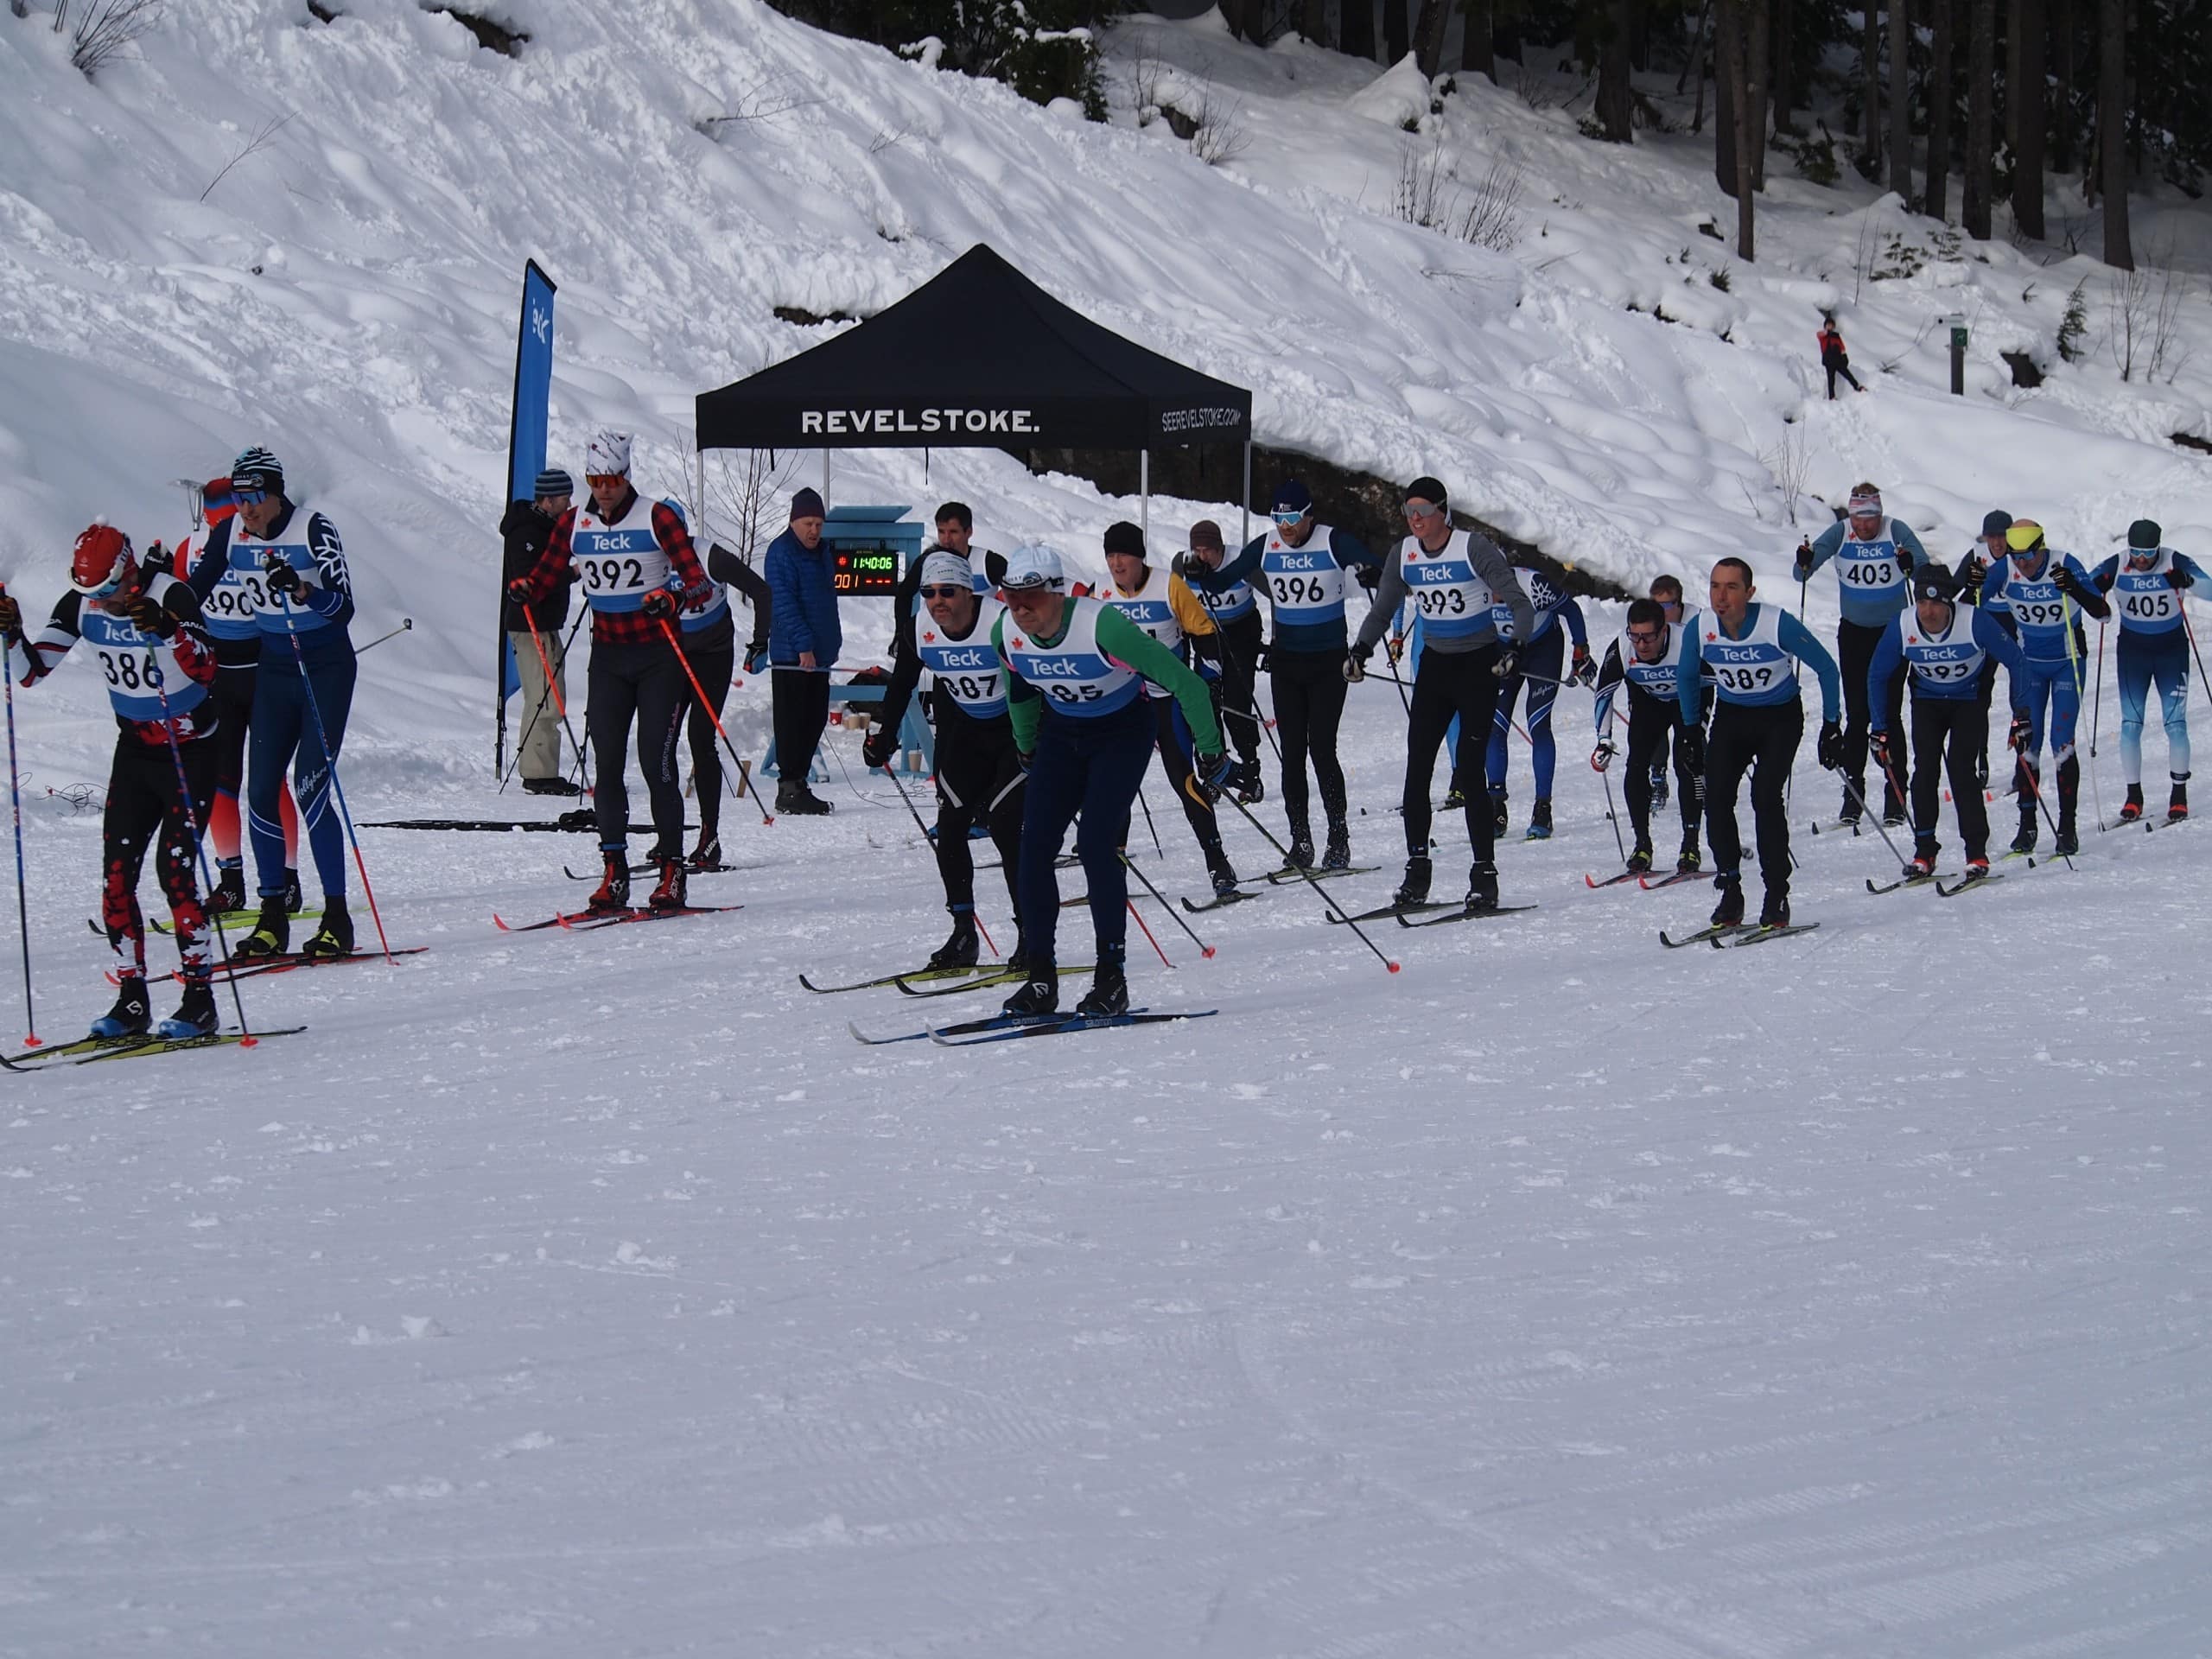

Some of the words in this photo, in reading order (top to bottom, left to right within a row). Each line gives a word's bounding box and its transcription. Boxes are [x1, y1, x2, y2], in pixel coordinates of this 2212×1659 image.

[802, 409, 1040, 434] REVELSTOKE.
[592, 533, 631, 550] Teck
[1855, 544, 1884, 557] Teck
[853, 556, 893, 569] 11:40:06
[1280, 554, 1313, 569] Teck
[585, 559, 644, 590] 392
[1419, 564, 1452, 582] Teck
[1847, 563, 1891, 584] 403
[1274, 576, 1324, 603] 396
[2131, 576, 2161, 589] Teck
[2019, 585, 2053, 599] Teck
[1417, 588, 1465, 615] 393
[2126, 594, 2169, 617] 405
[2016, 604, 2063, 624] 399
[102, 620, 144, 642] Teck
[938, 650, 983, 667] Teck
[1719, 647, 1761, 661] Teck
[1920, 647, 1959, 660] Teck
[99, 652, 165, 690] 386
[1028, 658, 1080, 676] Teck
[1640, 665, 1676, 680] Teck
[1719, 667, 1772, 690] 389
[94, 1035, 152, 1049] FISCHER
[163, 1036, 220, 1051] FISCHER
